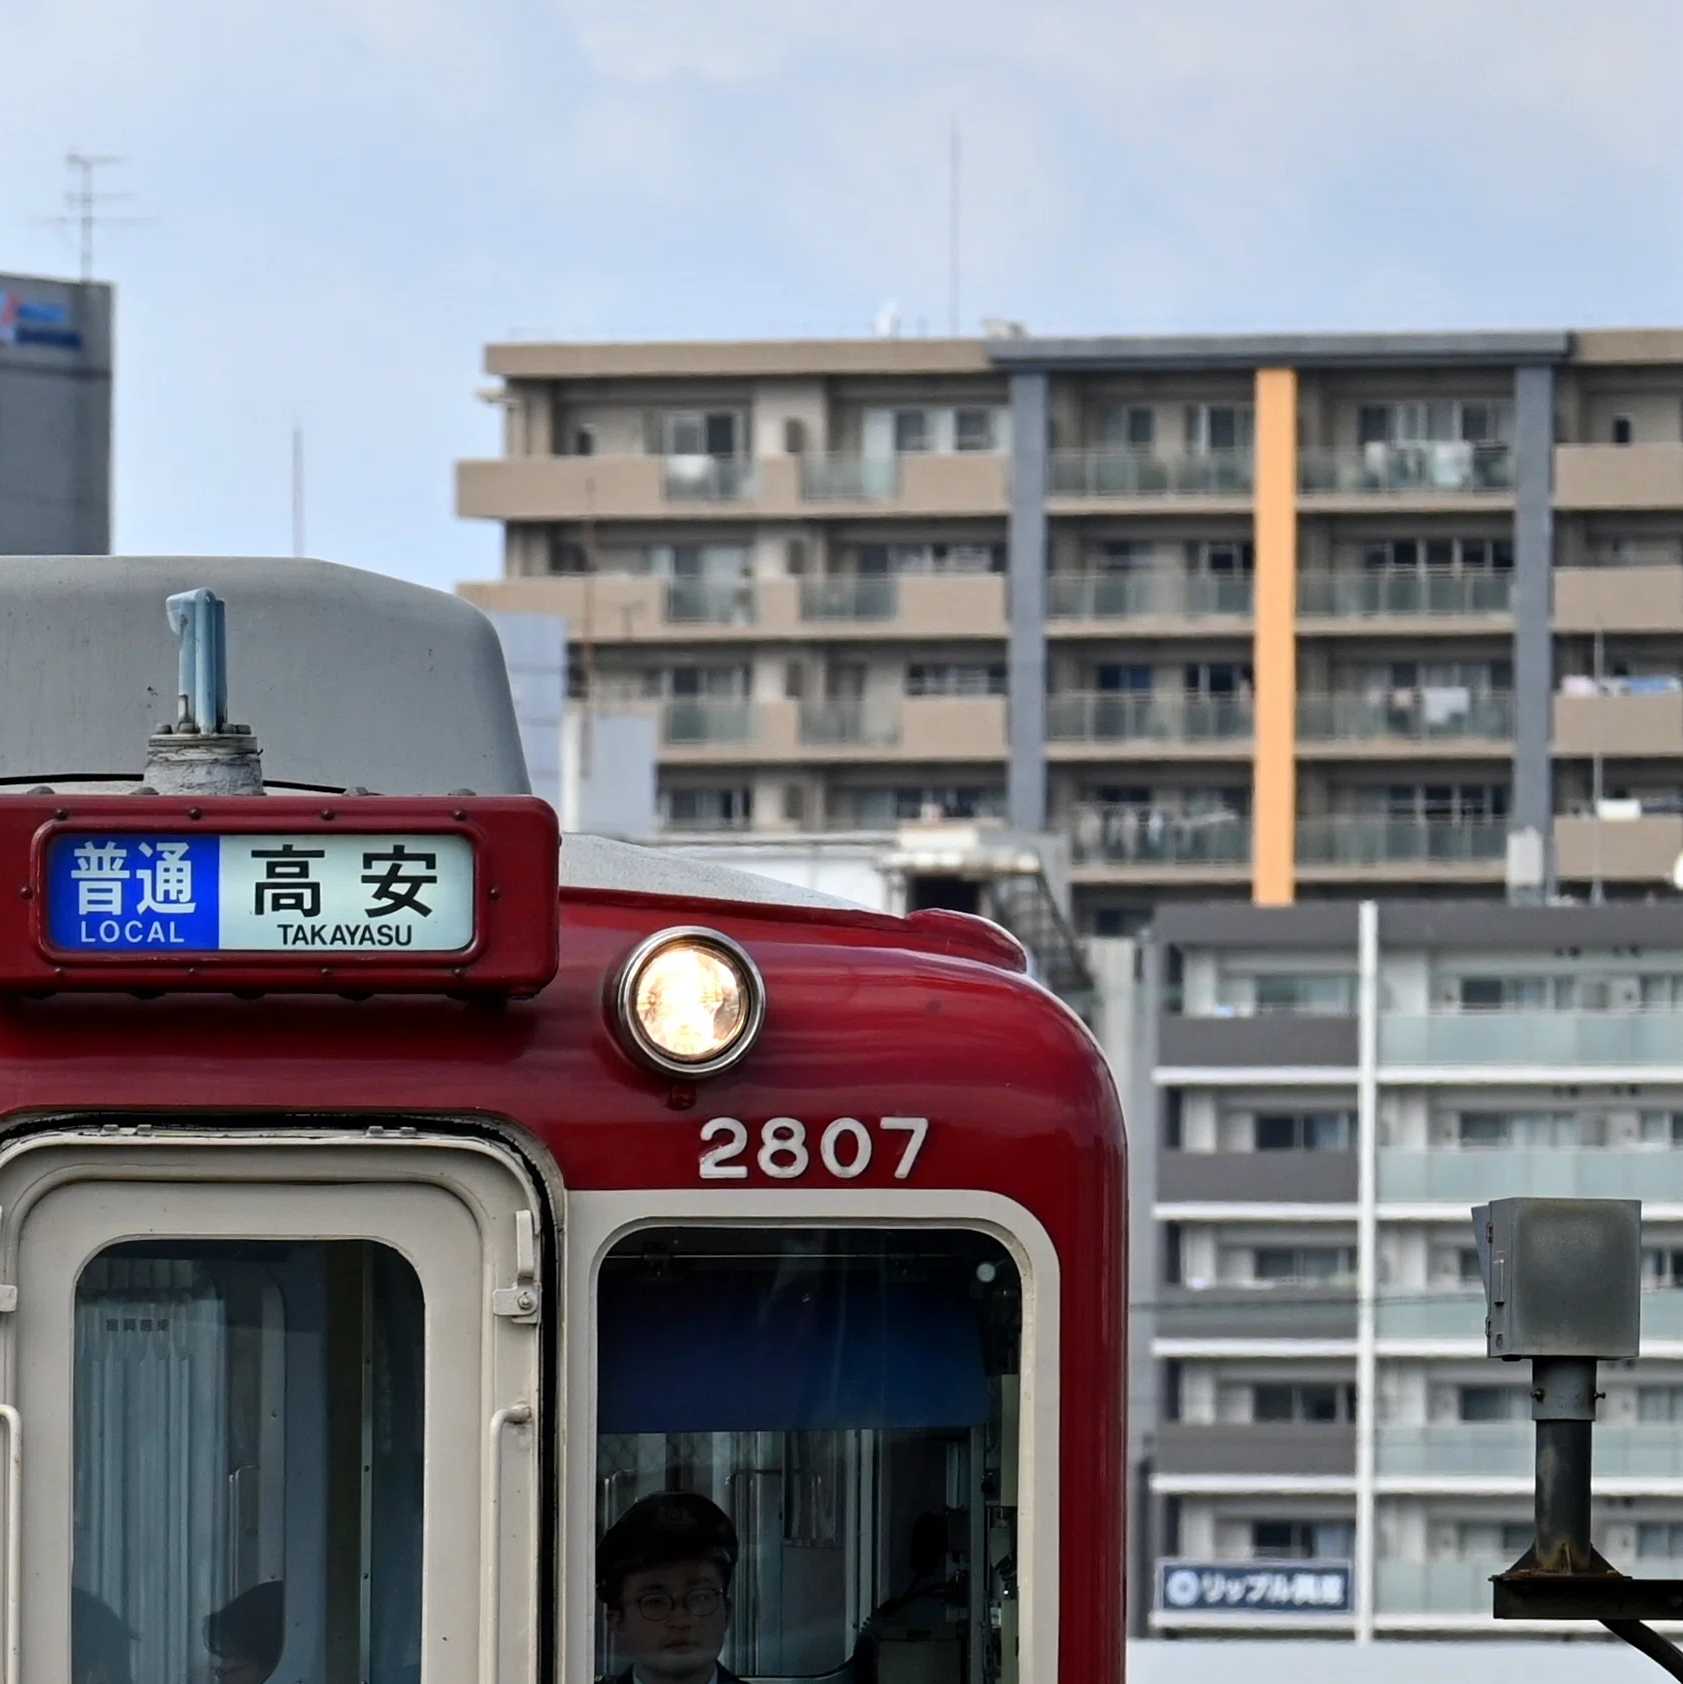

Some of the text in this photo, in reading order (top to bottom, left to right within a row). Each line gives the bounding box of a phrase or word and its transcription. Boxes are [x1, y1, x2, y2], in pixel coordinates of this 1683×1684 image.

[70, 840, 197, 916] 普通
[249, 844, 438, 918] 高安
[80, 920, 185, 943] LOCAL
[277, 923, 412, 946] TAKAYASU
[699, 1117, 929, 1178] 2807
